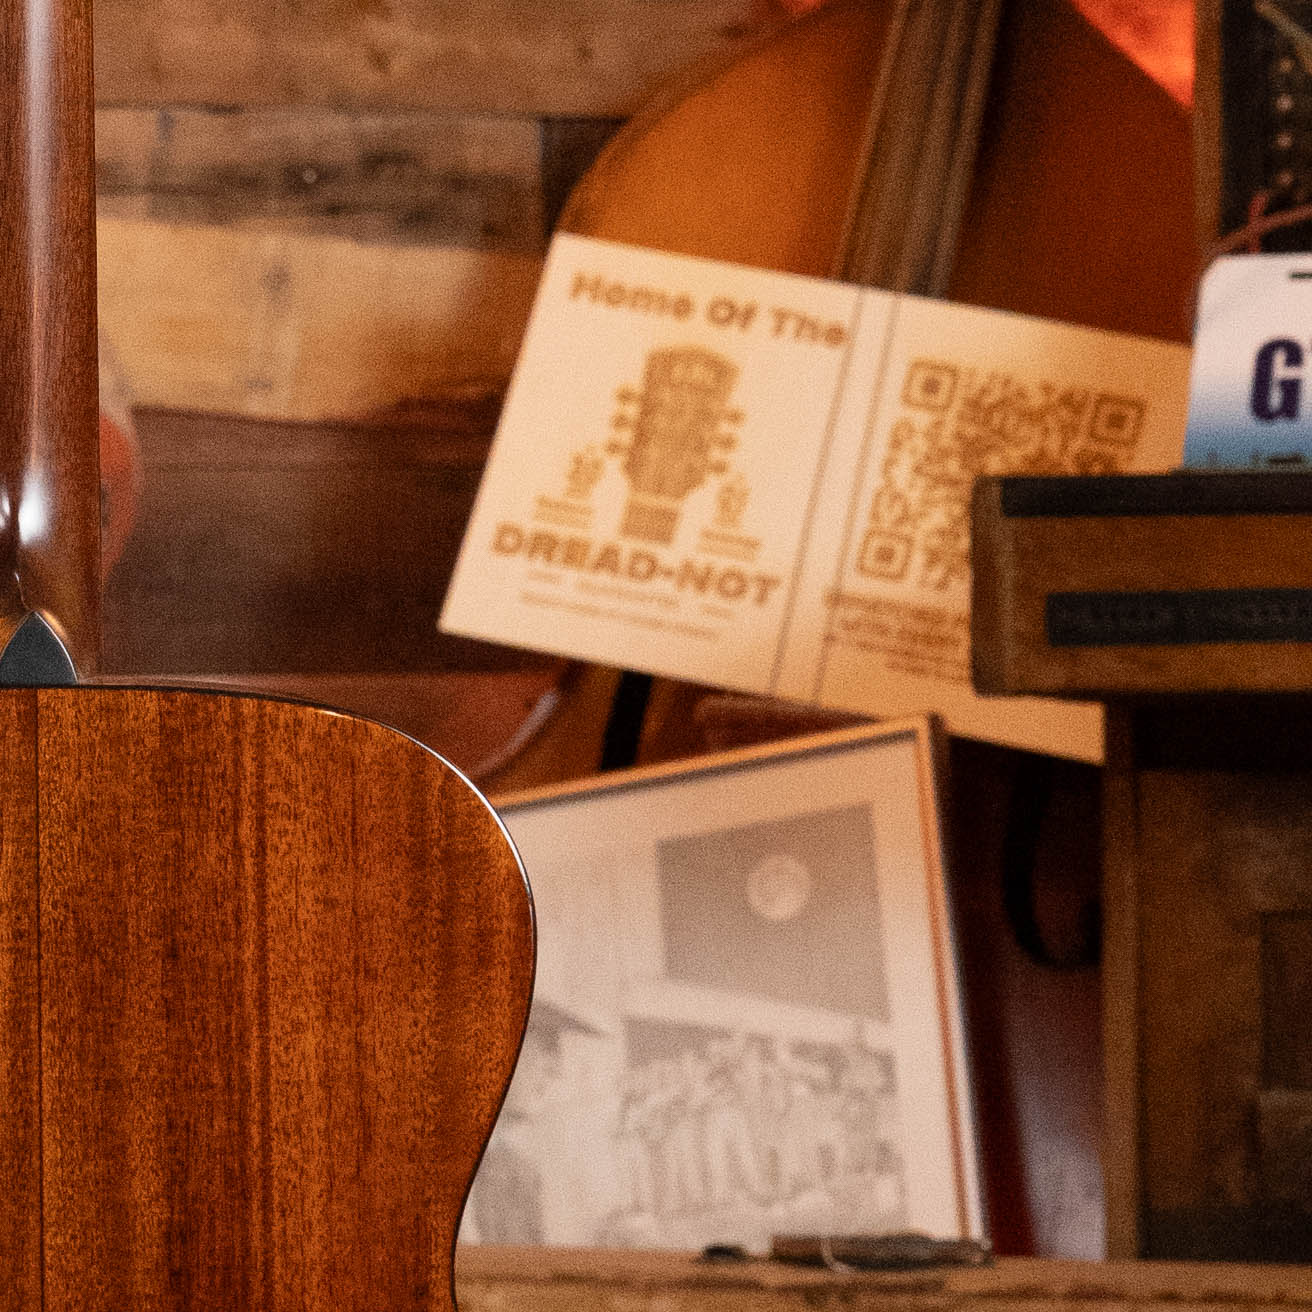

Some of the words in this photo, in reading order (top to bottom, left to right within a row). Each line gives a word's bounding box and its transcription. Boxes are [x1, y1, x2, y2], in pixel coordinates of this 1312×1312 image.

[569, 272, 693, 322] Home
[706, 295, 758, 332] Of
[770, 307, 850, 348] The
[492, 523, 782, 607] DREAD-NOT
